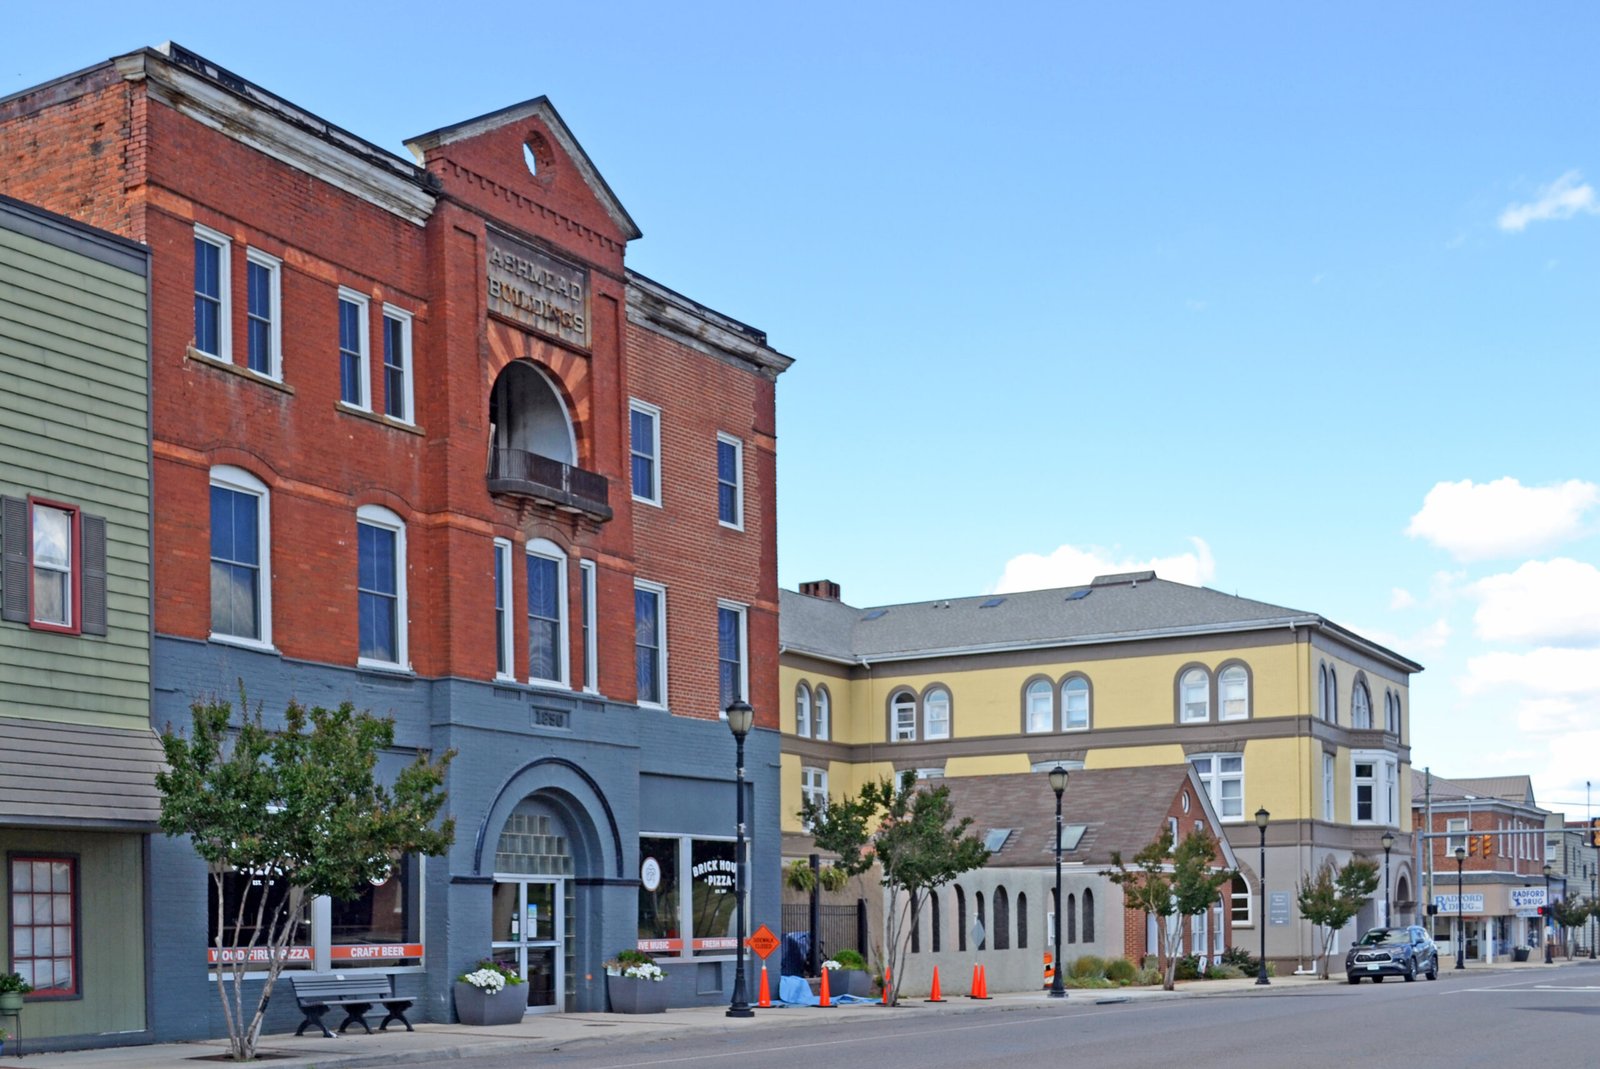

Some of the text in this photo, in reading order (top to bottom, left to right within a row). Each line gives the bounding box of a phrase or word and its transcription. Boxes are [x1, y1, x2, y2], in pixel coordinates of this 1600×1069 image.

[489, 246, 581, 302] ASHMEAD
[488, 276, 584, 334] BUILDINGS
[692, 860, 737, 877] BRICK HOU
[708, 875, 732, 886] PIZZA
[351, 946, 404, 958] CRAFT BEER
[638, 941, 648, 950] IVE
